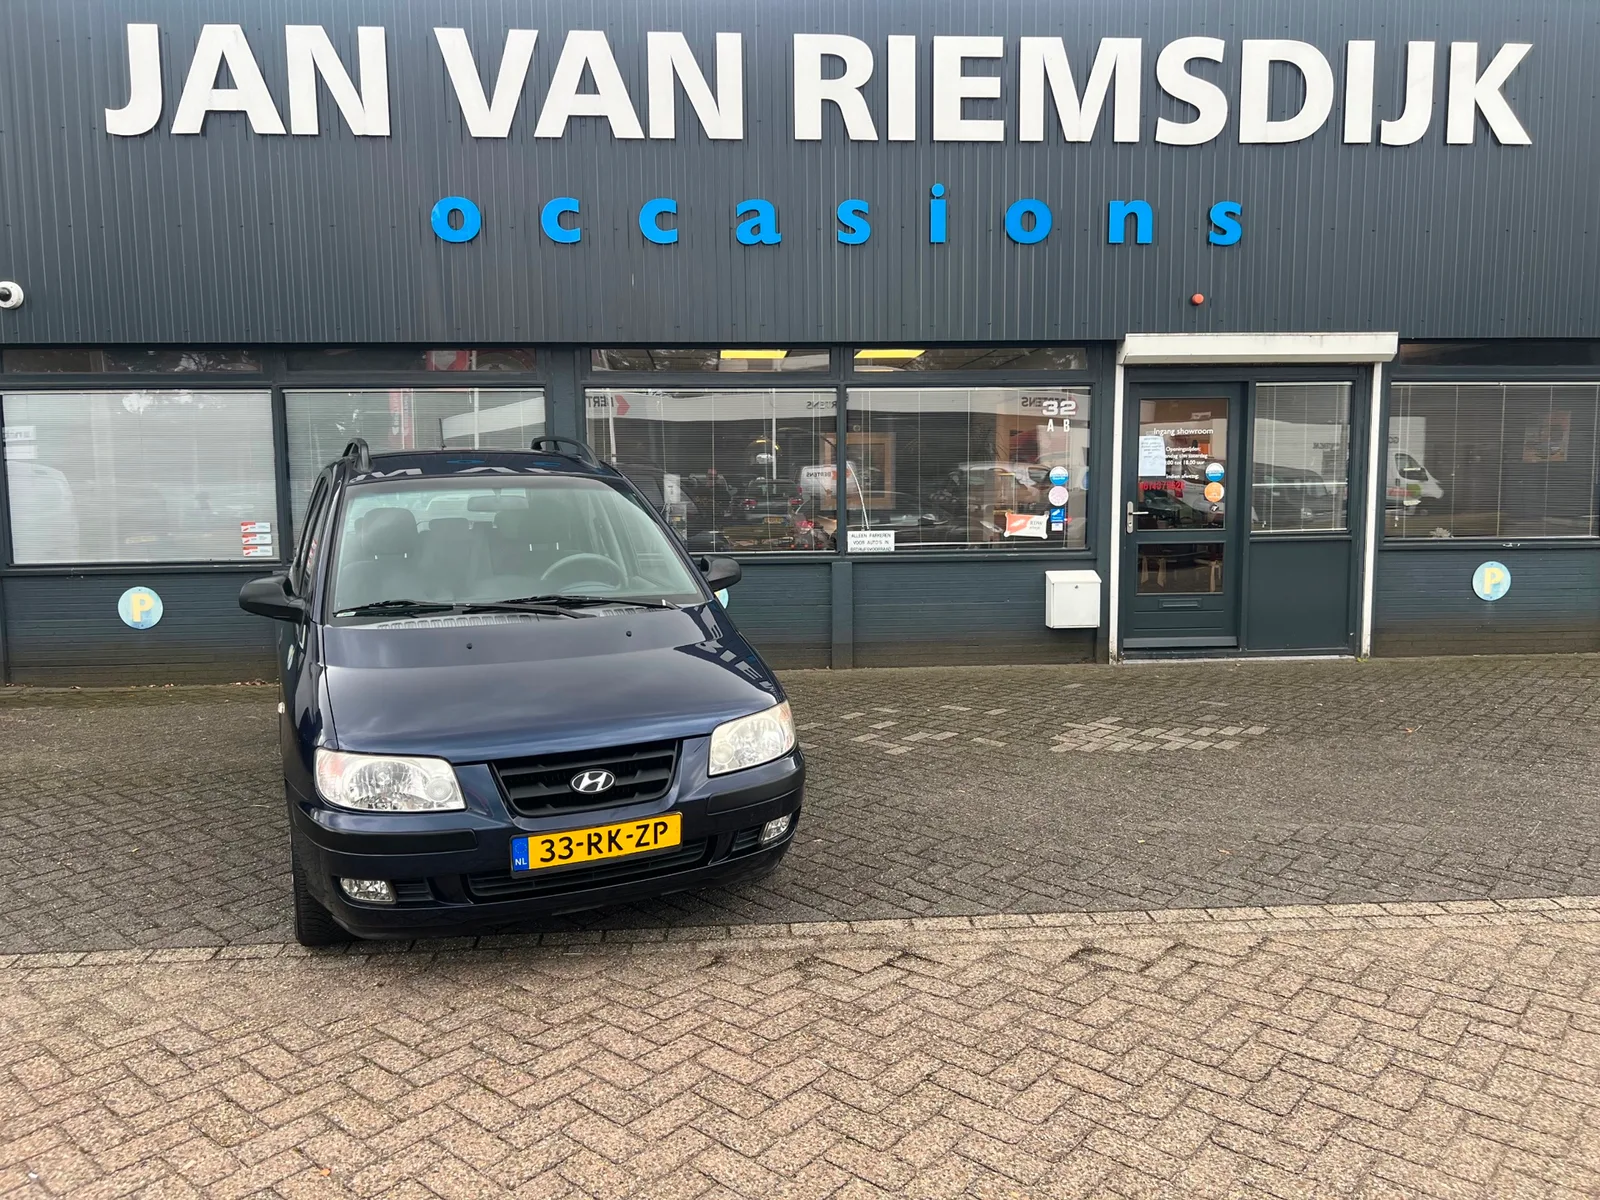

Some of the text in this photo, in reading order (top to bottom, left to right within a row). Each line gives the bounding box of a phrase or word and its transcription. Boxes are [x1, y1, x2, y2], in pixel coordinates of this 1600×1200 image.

[104, 23, 1534, 146] JAN VAN RIEMSDIJK
[431, 183, 1243, 246] occasions
[1042, 401, 1077, 416] 32
[1047, 418, 1071, 433] A B
[1153, 428, 1176, 436] Ingang
[1483, 567, 1504, 595] P
[131, 592, 154, 623] P
[539, 821, 669, 863] 33-RK-ZP
[514, 858, 528, 866] NL
